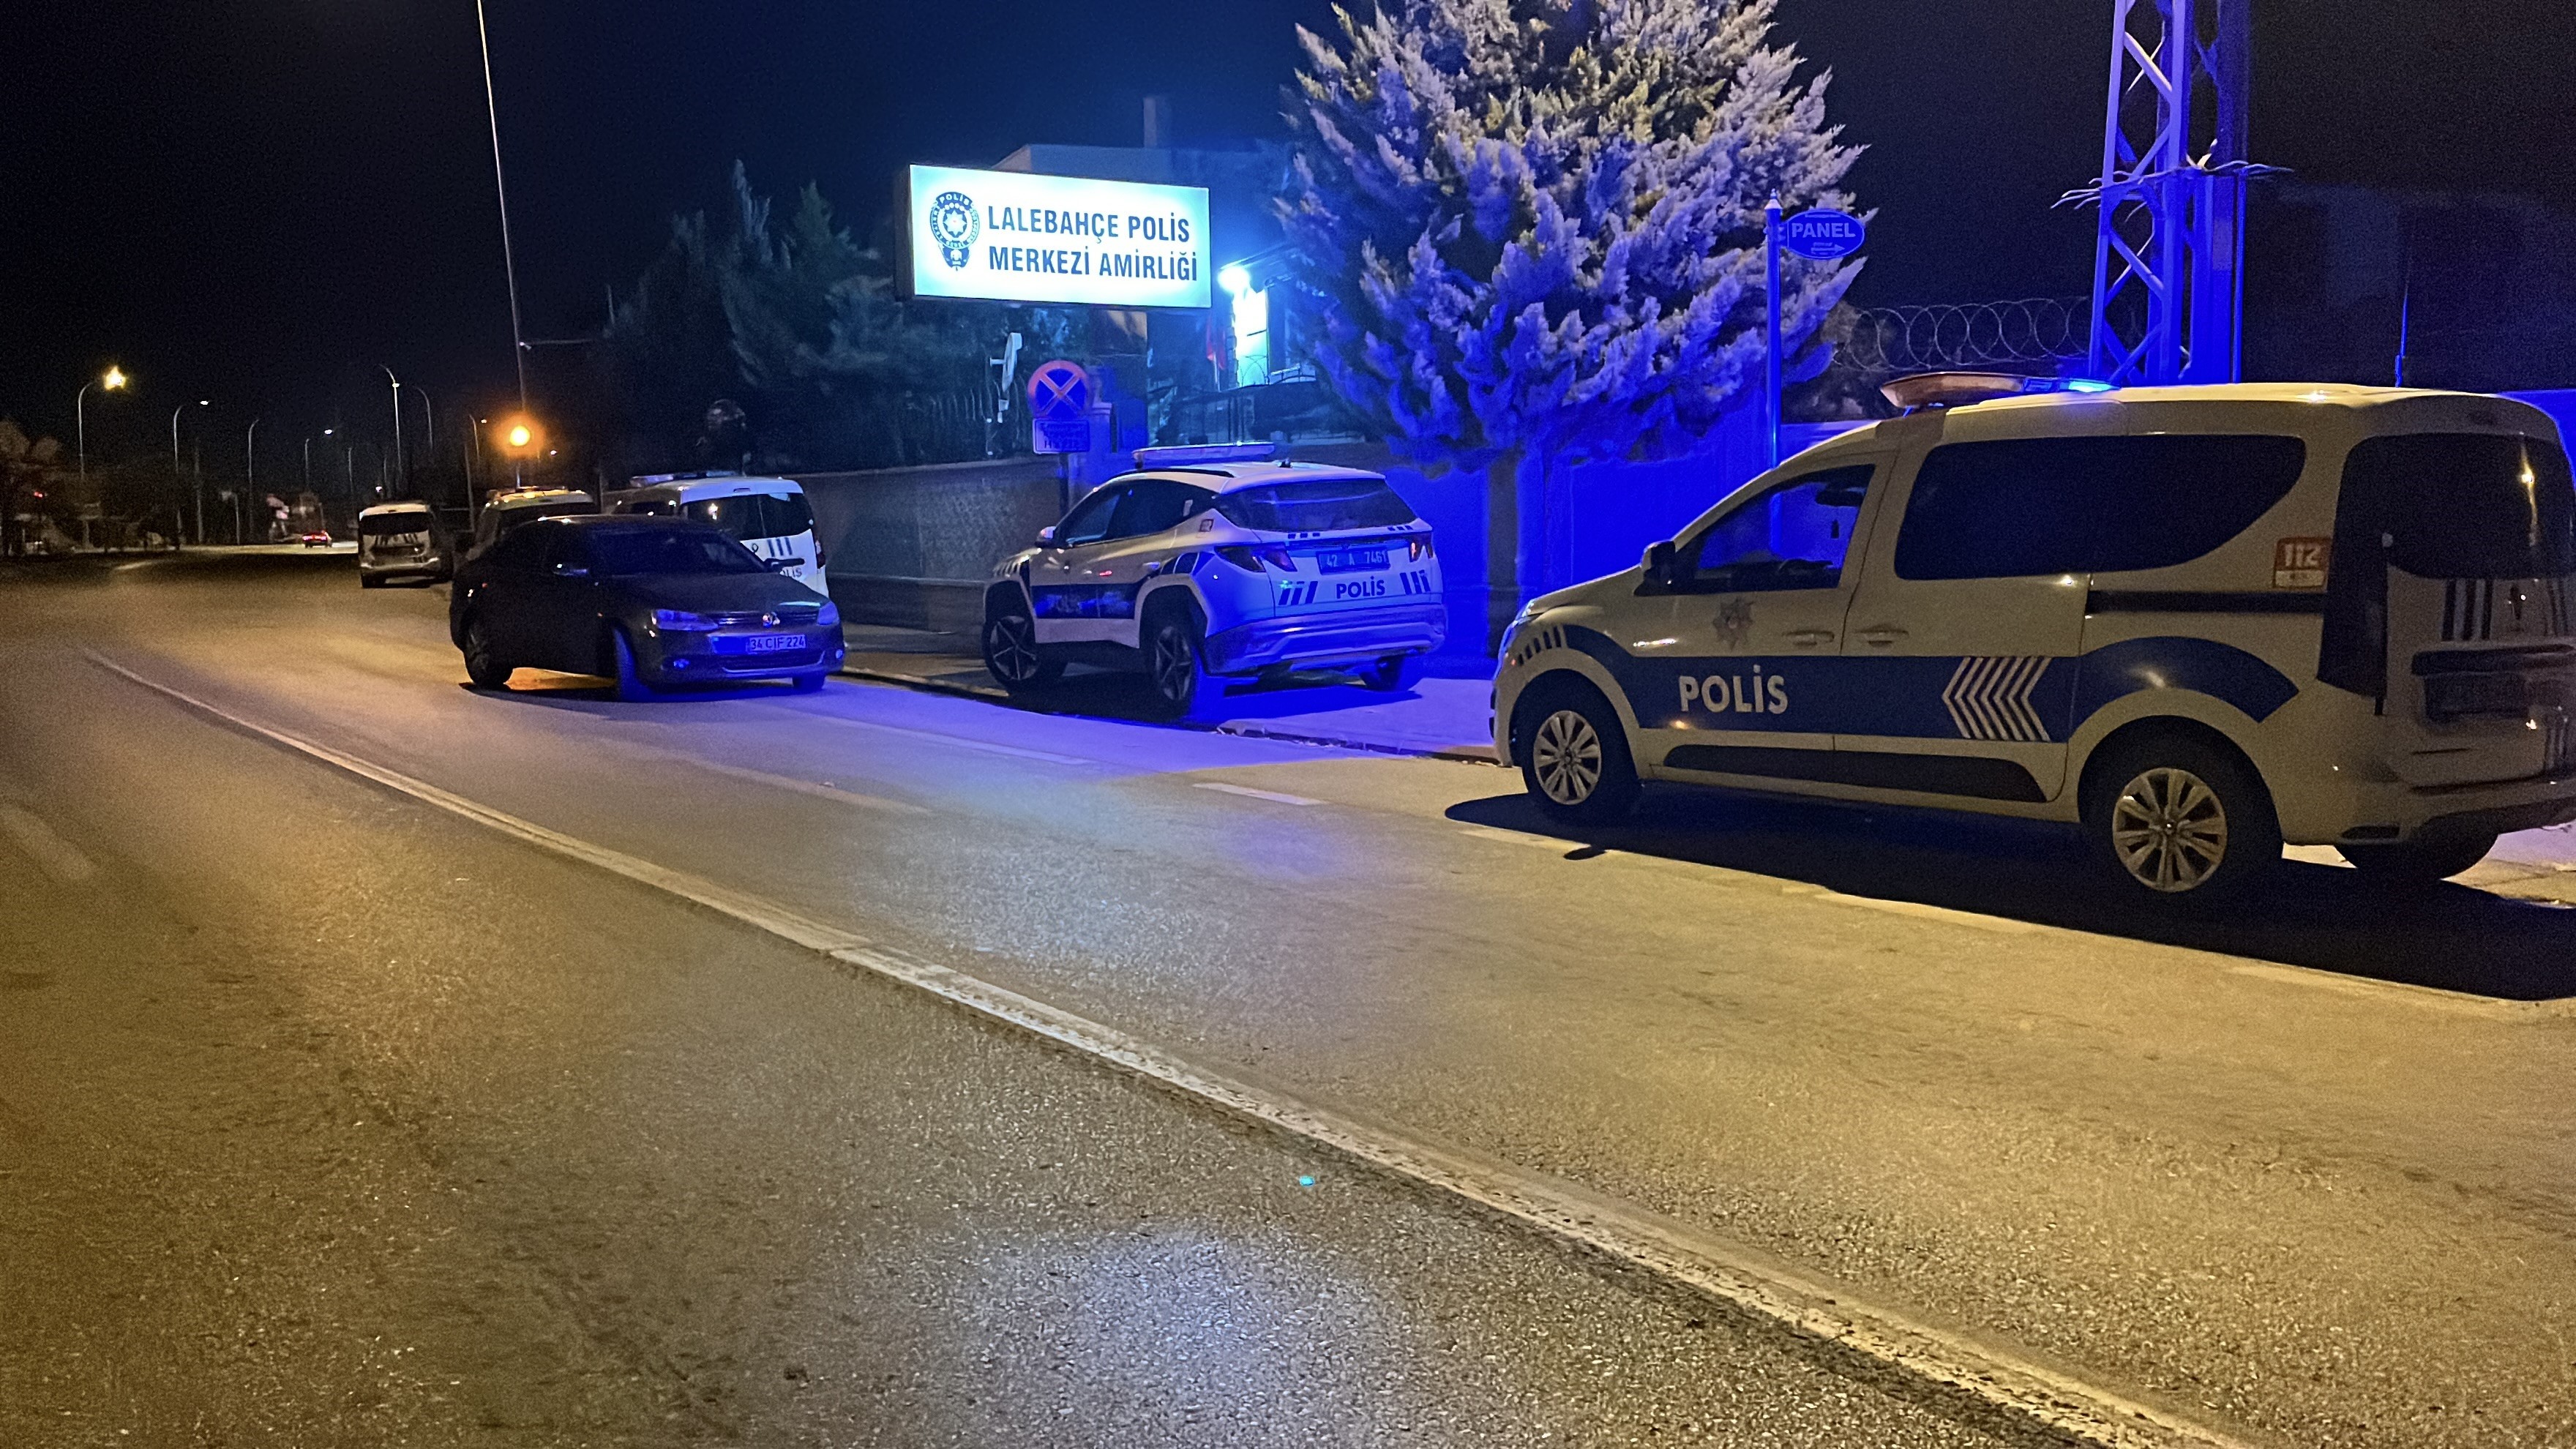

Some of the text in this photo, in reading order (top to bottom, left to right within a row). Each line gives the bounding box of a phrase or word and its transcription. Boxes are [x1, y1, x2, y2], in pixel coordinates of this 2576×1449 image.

[988, 206, 1118, 244] LALEBAHÇE
[1128, 212, 1190, 242] POLİS
[1792, 222, 1856, 238] PANEL
[989, 246, 1197, 281] MERKEZİ AMİRLİĞİ
[1326, 554, 1338, 566] 42
[1349, 553, 1355, 566] A
[2285, 543, 2321, 568] 112
[1336, 576, 1385, 599] POLİS
[750, 639, 763, 650] 34
[787, 636, 804, 648] 224
[1679, 664, 1789, 714] POLİS
